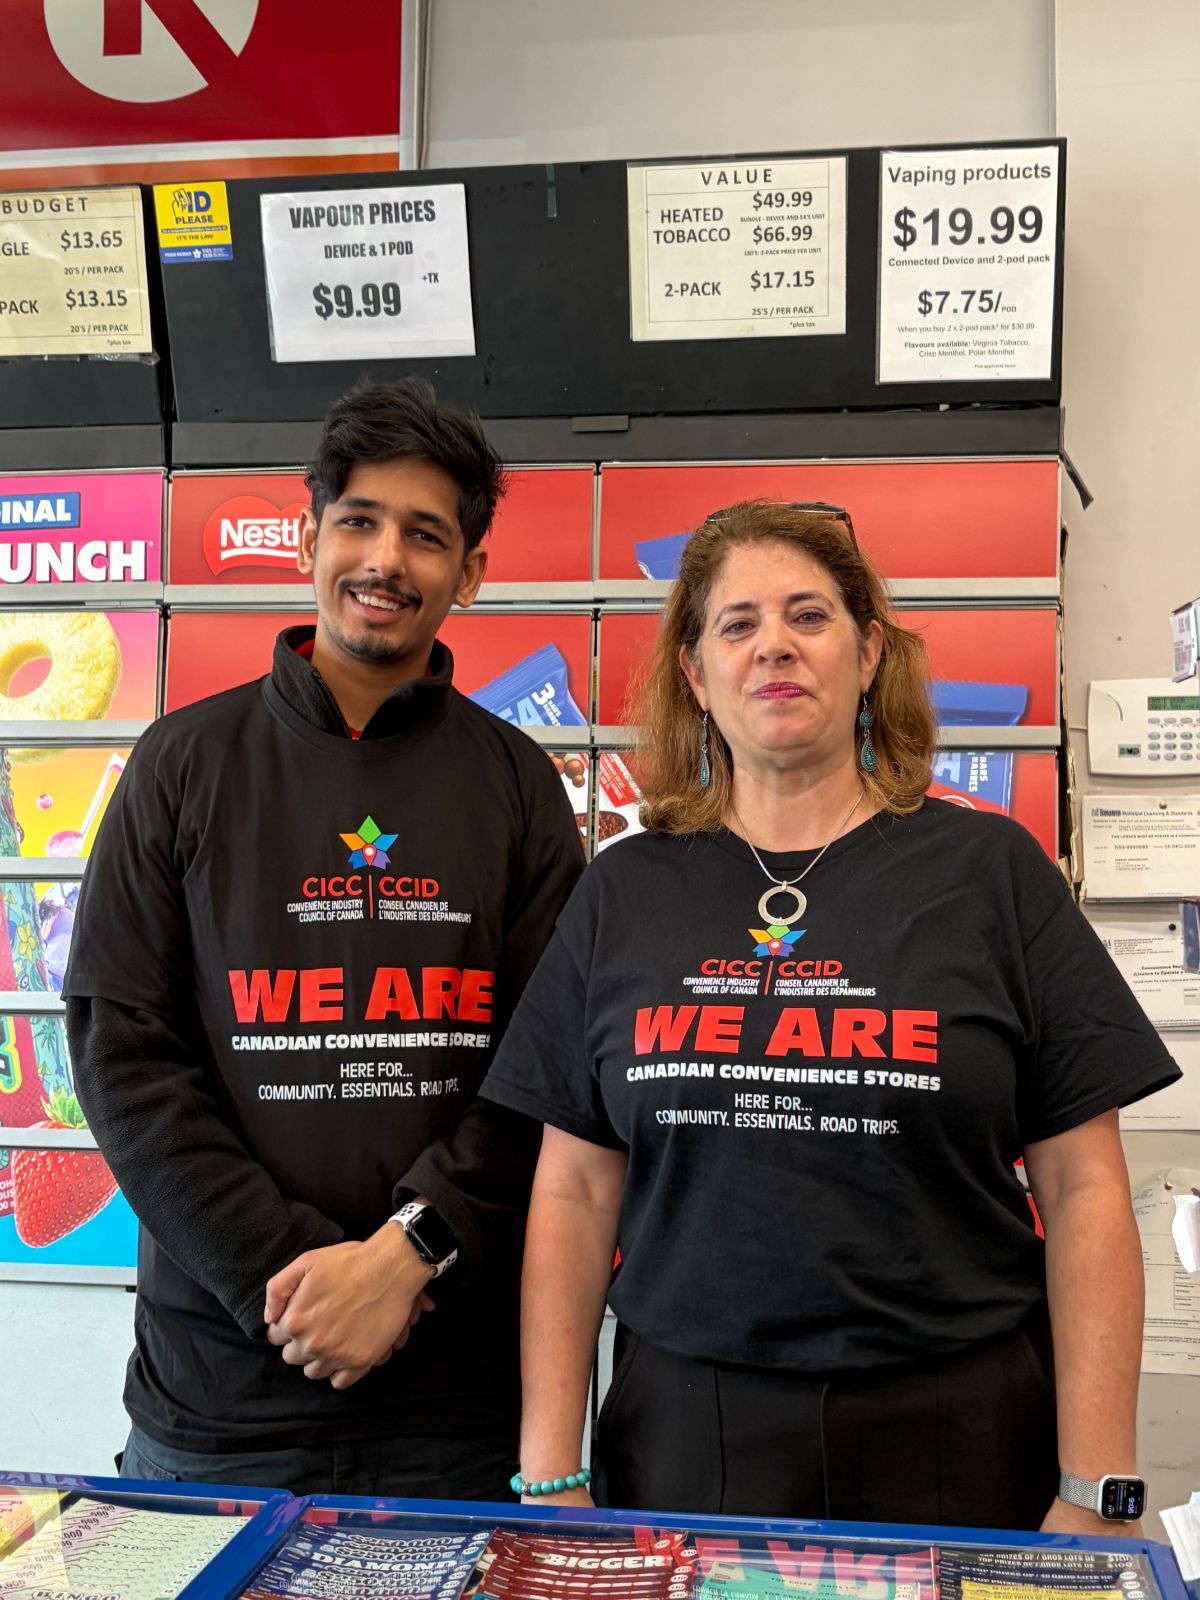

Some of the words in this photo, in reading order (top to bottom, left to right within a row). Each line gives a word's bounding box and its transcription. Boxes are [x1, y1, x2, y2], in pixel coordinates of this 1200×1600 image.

[700, 168, 772, 186] VALUE
[888, 165, 957, 187] Vaping
[963, 162, 1051, 185] products
[2, 197, 88, 214] BUDGET
[186, 190, 211, 213] ID
[752, 191, 813, 211] $49.99
[175, 215, 214, 224] PLEASE
[289, 204, 364, 229] VAPOUR
[369, 200, 436, 224] PRICES
[660, 207, 724, 224] HEATED
[653, 227, 731, 244] TOBACCO
[752, 225, 813, 245] $66.99
[892, 205, 1043, 252] $19.99
[0, 242, 30, 257] GLE
[61, 229, 123, 252] $13.65
[324, 243, 366, 259] DEVICE
[369, 244, 378, 257] &
[380, 243, 386, 256] 1
[389, 241, 413, 255] POD
[888, 256, 939, 267] Connected
[942, 256, 974, 265] Device
[977, 255, 994, 264] and
[997, 255, 1025, 265] 2-pod
[1028, 254, 1050, 265] pack
[64, 266, 80, 275] 20'S
[87, 266, 102, 274] PER
[103, 265, 124, 274] PACK
[664, 281, 722, 298] 2-PACK
[750, 270, 815, 292] $17.15
[0, 299, 39, 314] PACK
[65, 289, 128, 310] $13.15
[312, 282, 401, 321] $9.99
[752, 308, 769, 316] 25'S
[776, 307, 791, 315] PER
[793, 306, 814, 315] PACK
[70, 324, 86, 334] 20'S
[93, 325, 107, 333] PER
[109, 324, 129, 333] PACK
[897, 325, 918, 333] When
[919, 326, 932, 334] you
[933, 325, 945, 333] buy
[959, 324, 978, 333] 2-pod
[1000, 323, 1010, 331] for
[904, 341, 935, 349] Flavours
[972, 339, 998, 348] Virginia
[918, 350, 936, 359] Crisp
[968, 348, 986, 356] Polar
[988, 348, 1015, 356] Menthol
[0, 498, 71, 524] INAL
[220, 518, 298, 548] Nestl
[531, 682, 555, 705] 3
[968, 756, 978, 793] BARRES
[979, 756, 988, 782] BARS
[302, 875, 363, 898] CICC
[378, 876, 440, 898] CCID
[287, 900, 331, 913] CONVENIENCE
[332, 898, 363, 910] INDUSTRY
[378, 899, 405, 910] CONSEIL
[405, 900, 439, 911] CANADIEN
[439, 901, 448, 911] DE
[299, 911, 326, 922] COUNCIL
[327, 910, 336, 920] OF
[337, 909, 364, 920] CANADA
[379, 910, 418, 921] L'INDUSTRIE
[418, 911, 431, 921] DES
[432, 910, 471, 923] DÉPANNEURS
[700, 959, 763, 977] CICC
[778, 960, 843, 977] CCID
[683, 977, 726, 986] CONVENIENCE
[727, 977, 760, 987] INDUSTRY
[692, 986, 719, 994] COUNCIL
[720, 986, 730, 994] OF
[730, 986, 758, 995] CANADA
[775, 979, 802, 987] CONSEIL
[803, 979, 838, 987] CANADIEN
[839, 979, 849, 987] DE
[228, 967, 344, 1023] WE
[364, 967, 495, 1023] ARE
[774, 987, 815, 996] L'INDUSTRIE
[816, 987, 829, 996] DES
[830, 986, 876, 997] DÉPANNEURS
[231, 1034, 321, 1050] CANADIAN
[324, 1032, 448, 1049] CONVENIENCE
[634, 1005, 746, 1056] WE
[764, 1007, 938, 1064] ARE
[340, 1063, 374, 1078] HERE
[378, 1062, 413, 1078] FOR...
[626, 1062, 714, 1082] CANADIAN
[719, 1064, 858, 1085] CONVENIENCE
[863, 1071, 941, 1091] STORES
[258, 1084, 337, 1100] COMMUNITY.
[341, 1081, 416, 1098] ESSENTIALS.
[421, 1080, 443, 1096] ROAD
[734, 1093, 769, 1109] HERE
[774, 1095, 813, 1112] FOR...
[735, 1112, 815, 1131] ESSENTIALS.
[820, 1116, 858, 1133] ROAD
[861, 1118, 900, 1135] TRIPS.
[311, 1551, 458, 1572] DIAMOND
[544, 1553, 673, 1569] BIGGER
